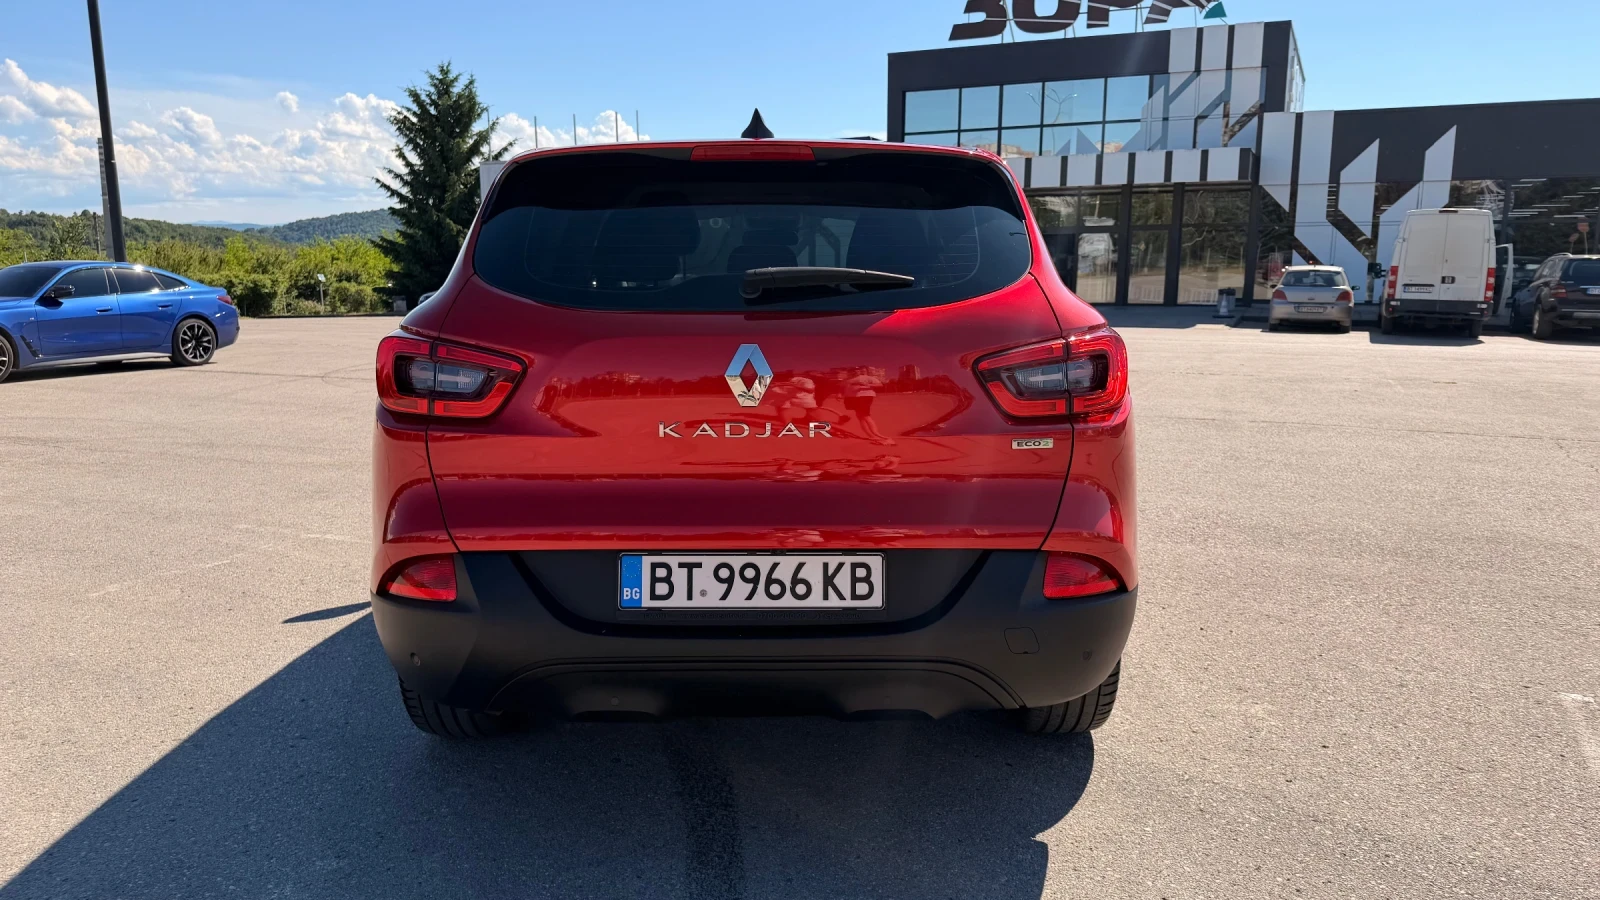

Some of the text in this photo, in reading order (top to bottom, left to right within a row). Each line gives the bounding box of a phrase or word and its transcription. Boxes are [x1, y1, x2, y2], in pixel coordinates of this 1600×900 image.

[658, 421, 833, 438] KADJAR
[649, 561, 875, 601] BT 9966 KB
[622, 587, 640, 600] BG
